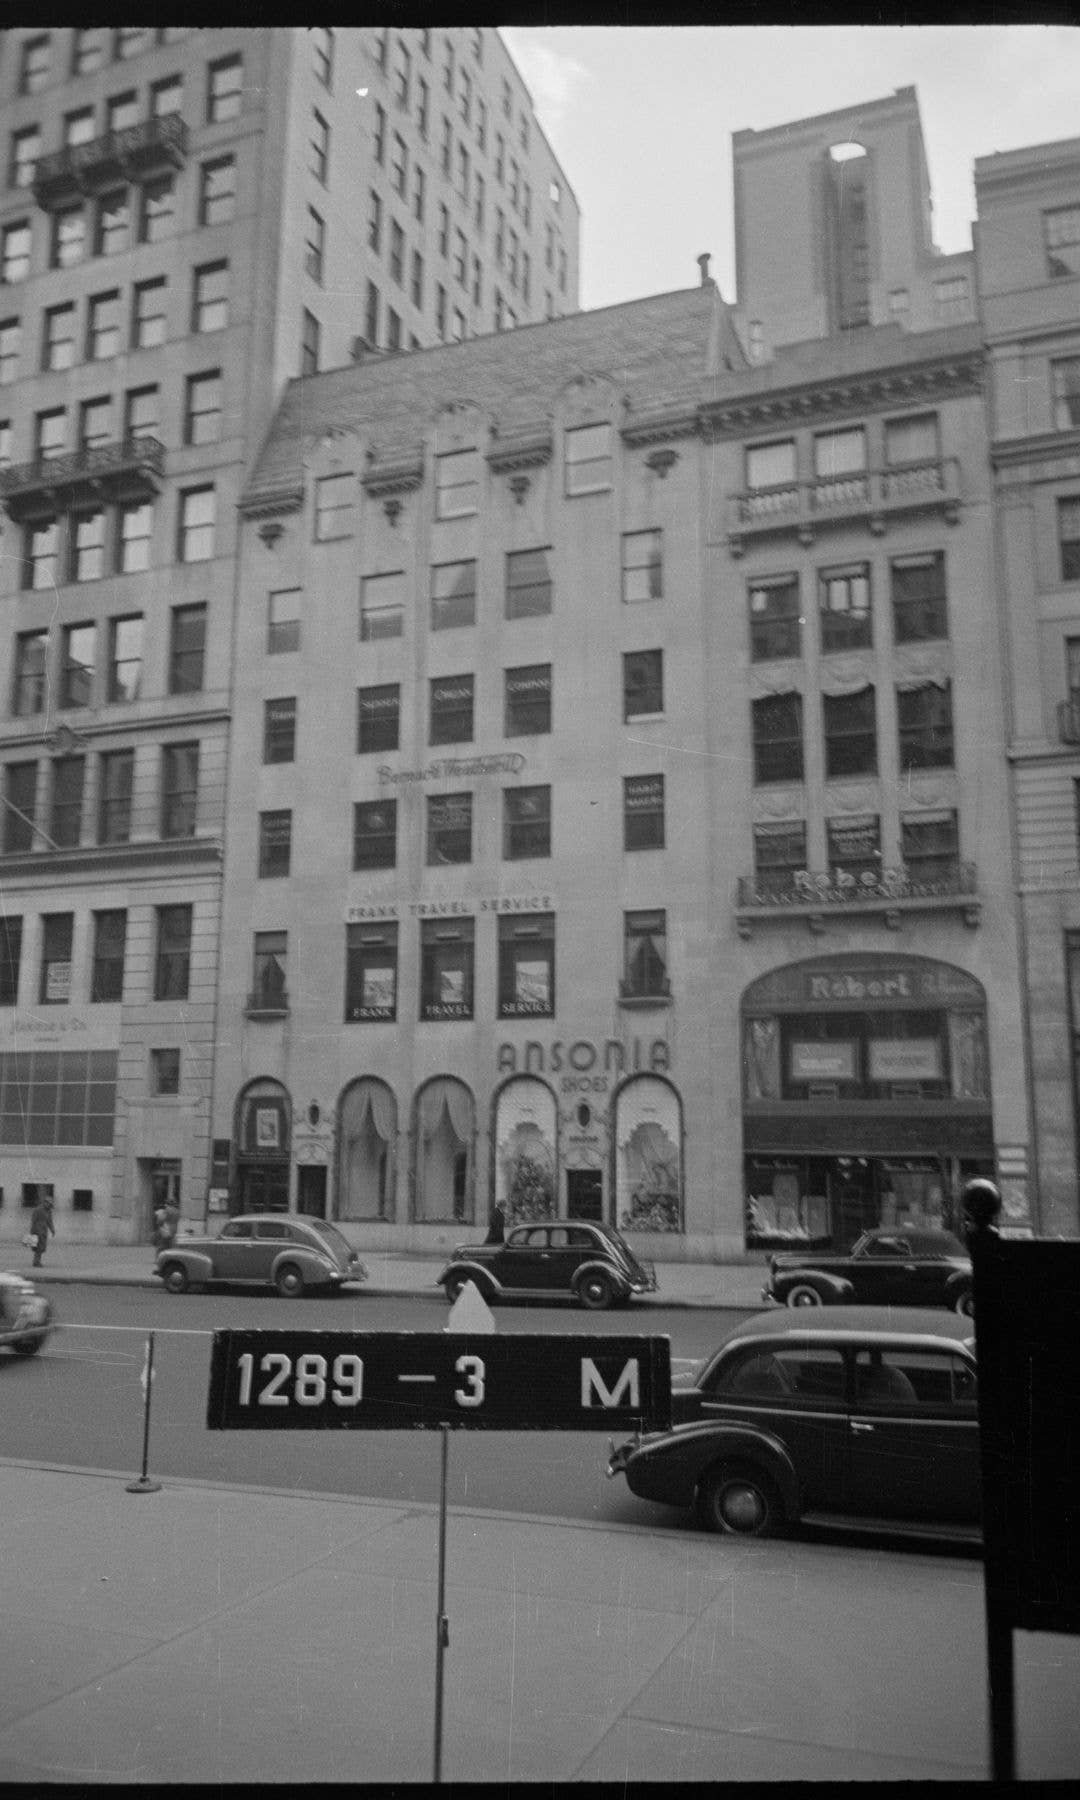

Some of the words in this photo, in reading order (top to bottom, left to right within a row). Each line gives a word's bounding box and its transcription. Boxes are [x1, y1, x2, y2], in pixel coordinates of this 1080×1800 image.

[348, 905, 399, 919] FRANK
[408, 900, 470, 915] TRAVEL
[480, 895, 552, 911] SERVICE
[811, 973, 912, 999] Robert
[353, 1007, 393, 1018] FRANK
[424, 1003, 470, 1015] TRAVEL
[502, 1001, 551, 1013] SERVICE
[561, 1076, 609, 1093] SHOES
[237, 1353, 364, 1406] 1289
[455, 1355, 485, 1407] 3
[581, 1357, 640, 1408] M
